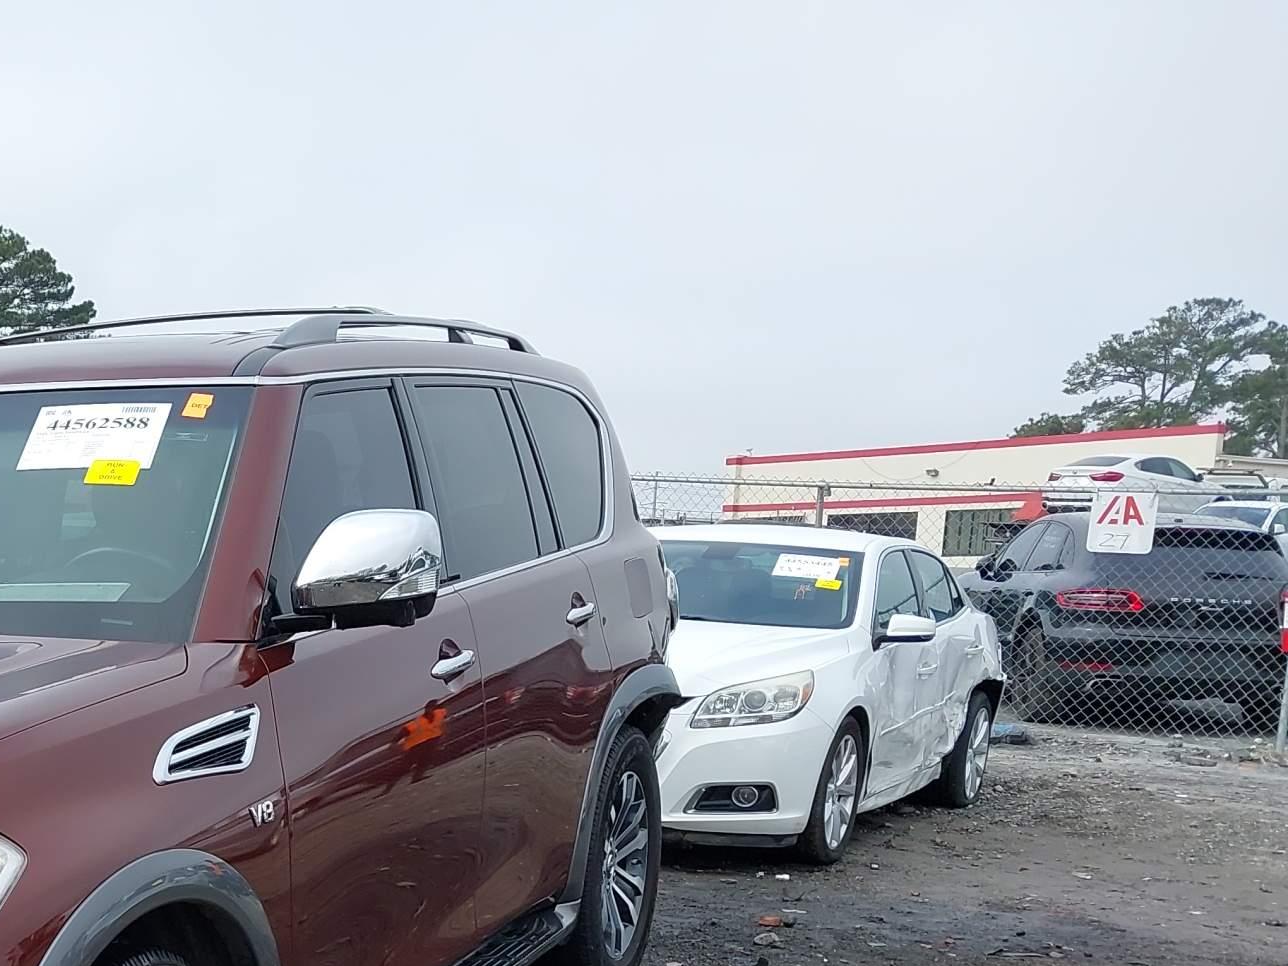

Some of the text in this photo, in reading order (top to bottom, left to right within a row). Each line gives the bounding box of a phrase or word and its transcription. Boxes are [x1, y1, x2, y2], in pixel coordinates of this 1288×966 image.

[47, 417, 150, 431] 44562588
[1098, 533, 1130, 550] 27
[248, 800, 274, 828] V8
